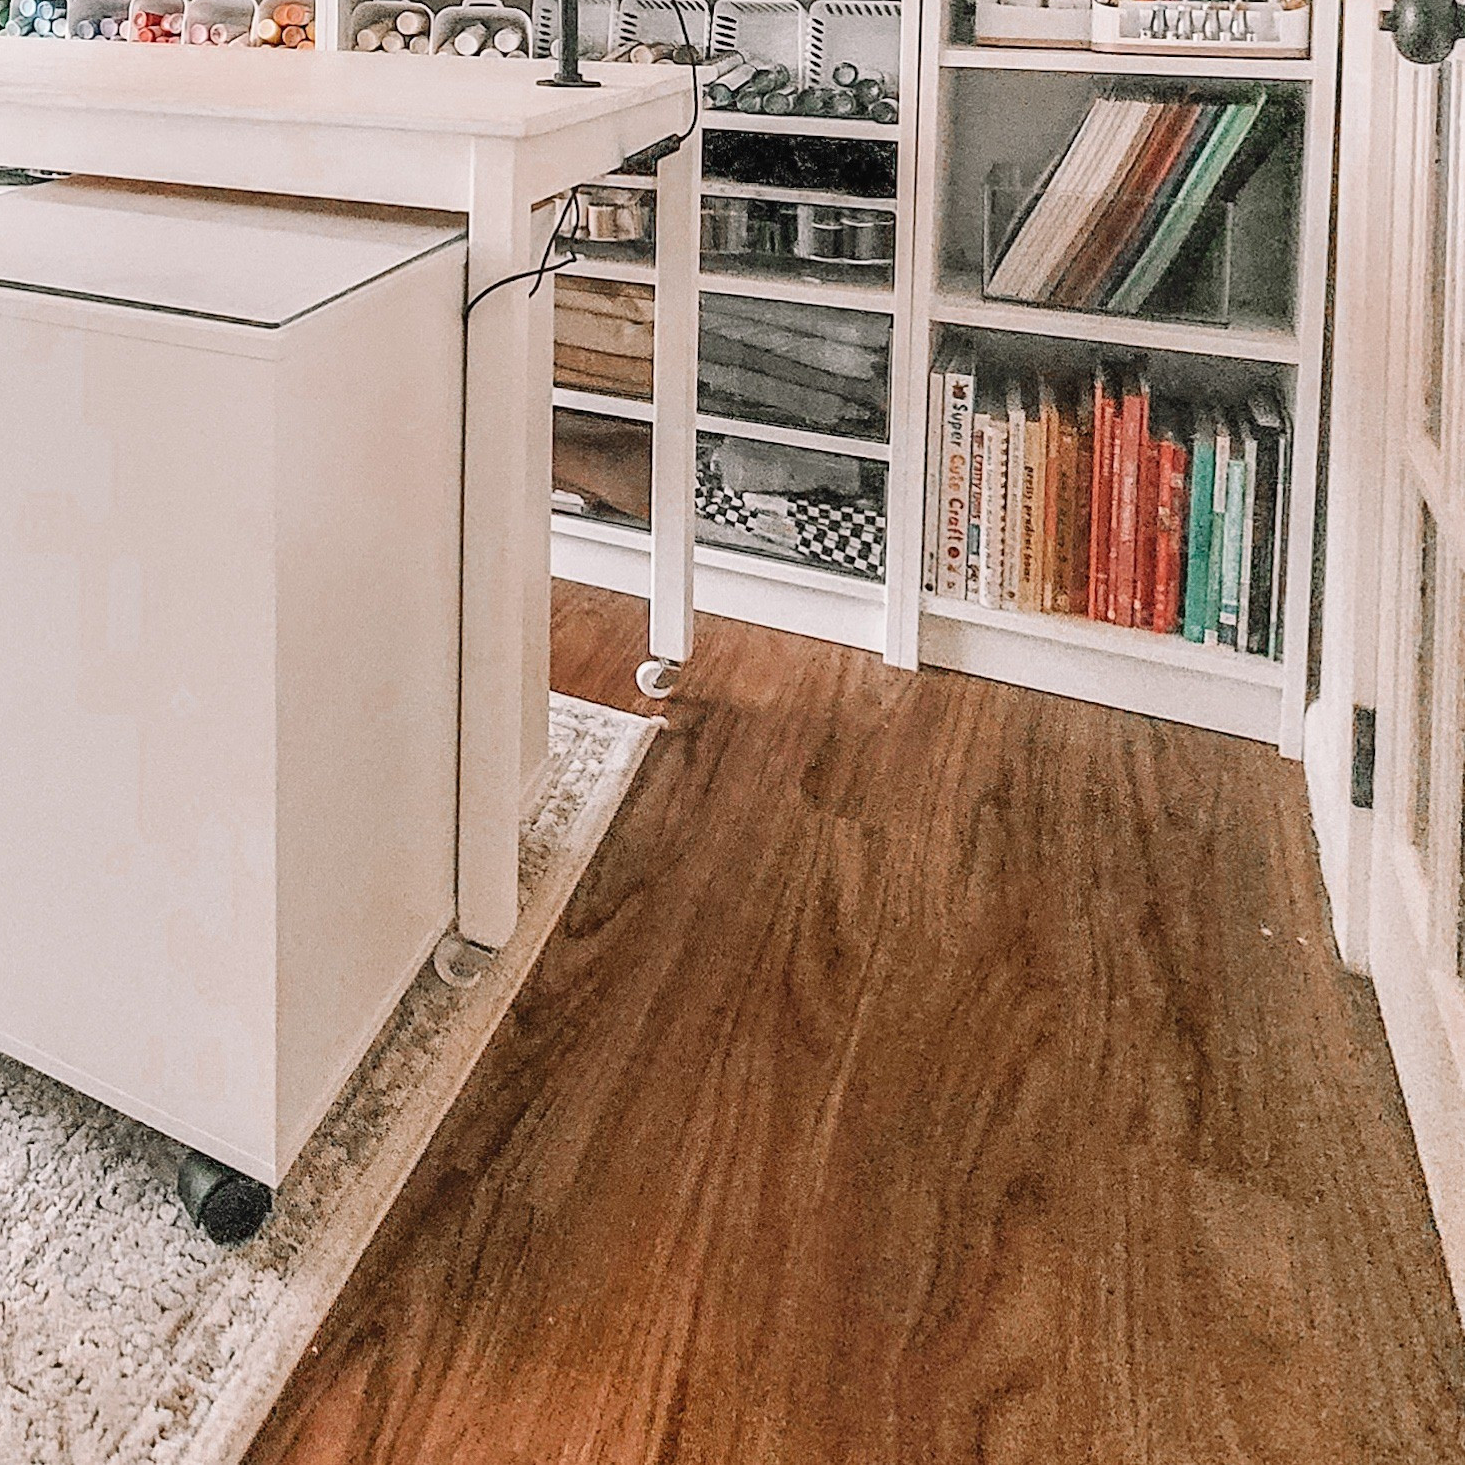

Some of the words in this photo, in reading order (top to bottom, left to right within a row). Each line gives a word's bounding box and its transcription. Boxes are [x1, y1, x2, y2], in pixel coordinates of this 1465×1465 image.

[948, 402, 969, 447] Super
[949, 455, 966, 490] Cute
[947, 498, 965, 542] Craft
